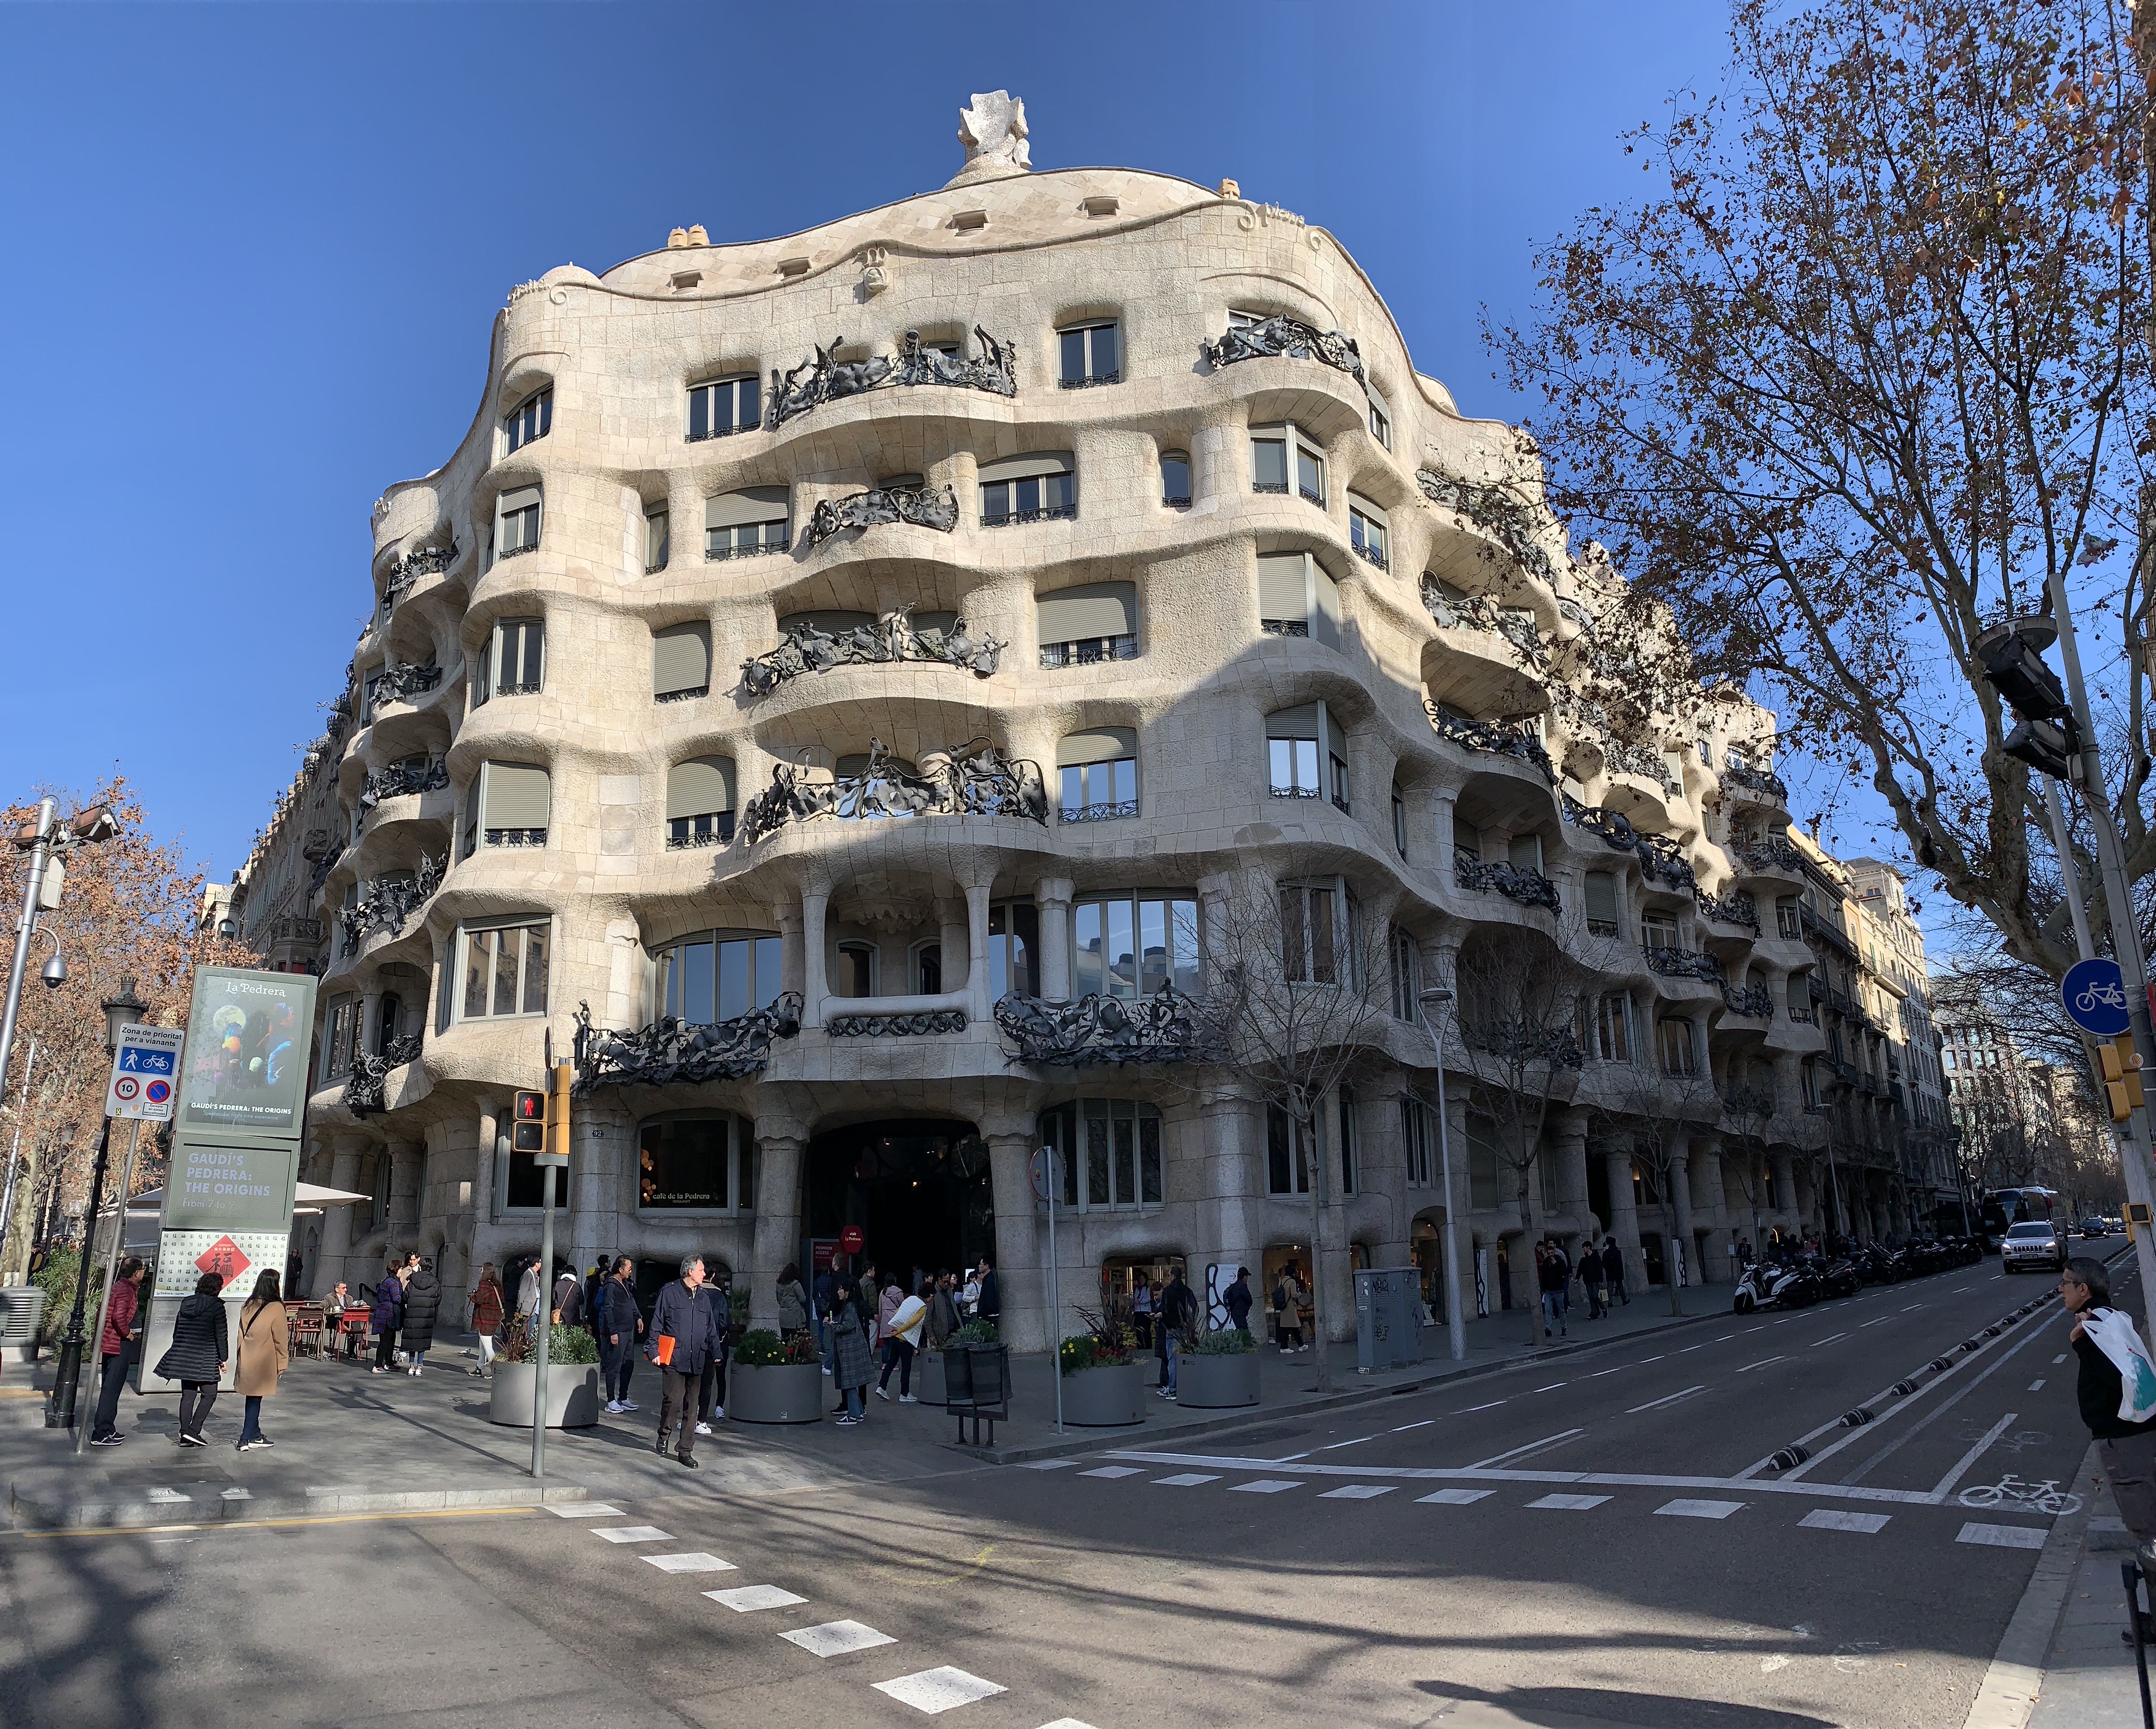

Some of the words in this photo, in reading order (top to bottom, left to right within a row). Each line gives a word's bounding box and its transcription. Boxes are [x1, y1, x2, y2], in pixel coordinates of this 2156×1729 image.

[225, 982, 238, 994] La
[240, 983, 286, 997] Pedrera
[122, 1027, 141, 1035] Zona
[153, 1032, 182, 1040] prioritat
[146, 1038, 176, 1047] vianants
[122, 1084, 133, 1092] 10
[189, 1152, 244, 1166] GAUDÍ'S
[186, 1167, 252, 1181] PEDRERA:
[185, 1182, 209, 1193] THE
[214, 1183, 270, 1197] ORIGINS
[182, 1198, 204, 1207] From
